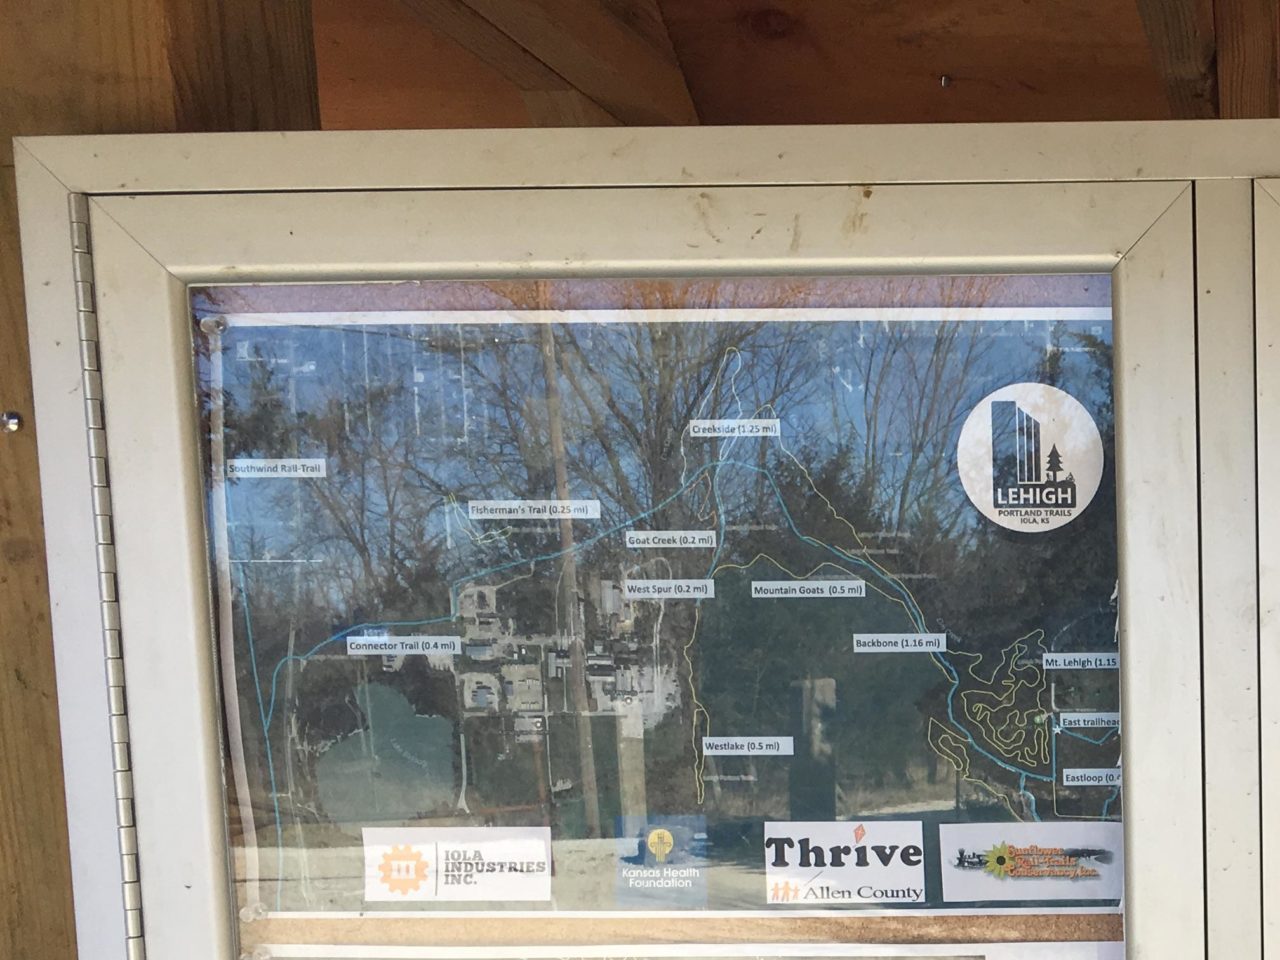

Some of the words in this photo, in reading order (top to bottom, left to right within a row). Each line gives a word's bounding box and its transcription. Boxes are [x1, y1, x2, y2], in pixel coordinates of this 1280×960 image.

[691, 423, 735, 434] Creekside
[737, 423, 761, 436] (1.25
[762, 423, 778, 436] mi)
[229, 463, 279, 474] Southwind
[997, 487, 1072, 504] LEHIGH
[527, 504, 548, 515] Trail
[549, 504, 572, 517] (0.25
[573, 504, 588, 517] mi)
[1044, 509, 1072, 517] TRAILS
[628, 534, 650, 546] Goat
[651, 534, 677, 546] Creek
[679, 535, 697, 547] (0.2
[698, 535, 714, 547] mi)
[627, 584, 650, 595] West
[651, 584, 672, 597] Spur
[673, 583, 692, 596] (0.2
[693, 583, 709, 596] mi)
[754, 585, 796, 596] Mountain
[798, 585, 824, 596] Goats
[829, 585, 847, 597] (0.5
[848, 585, 863, 597] mi)
[349, 640, 396, 652] Connector
[398, 640, 419, 651] Trail
[421, 640, 439, 653] (0.4
[440, 640, 456, 653] mi)
[856, 638, 899, 649] Backbone
[900, 638, 923, 650] (1.16
[924, 638, 941, 650] mi)
[1045, 658, 1061, 667] Mt.
[1063, 657, 1092, 668] Lehigh
[1094, 657, 1117, 668] (1.15
[705, 742, 745, 751] Westlake
[747, 742, 764, 752] (0.5
[765, 742, 780, 752] mi)
[765, 830, 923, 867] Thrive
[444, 850, 484, 861] IOLA
[444, 861, 546, 873] INDUSTRIES
[622, 868, 660, 878] Kansas
[663, 867, 700, 878] Health
[444, 874, 478, 885] INC.
[629, 878, 692, 888] Foundation
[803, 886, 852, 900] Allen
[857, 886, 923, 901] County
